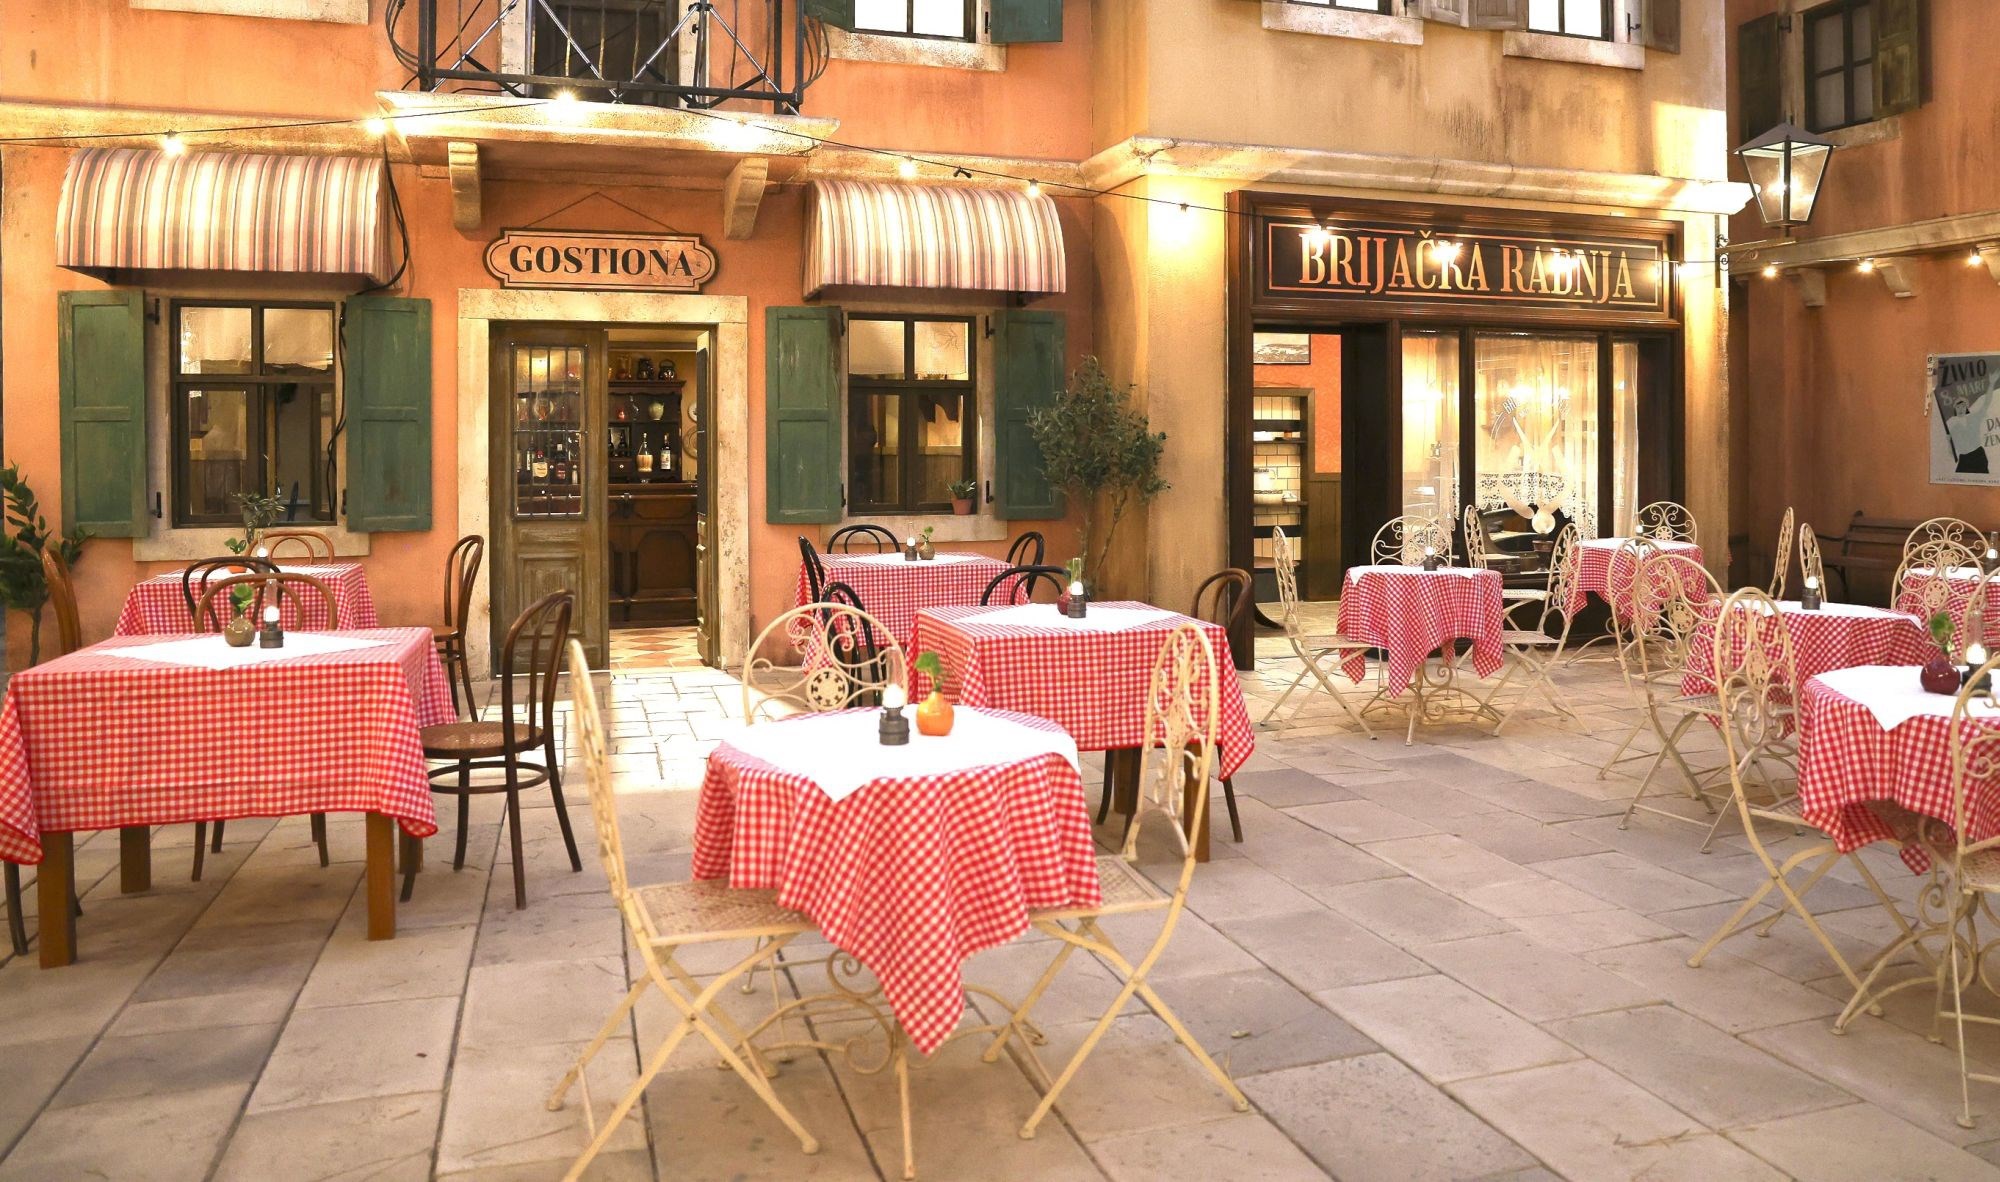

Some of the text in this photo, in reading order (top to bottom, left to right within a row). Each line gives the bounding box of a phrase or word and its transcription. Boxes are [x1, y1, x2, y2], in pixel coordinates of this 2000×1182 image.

[509, 245, 695, 276] GOSTIONA
[1299, 229, 1635, 304] BRIJAČKA RADNJA
[1938, 359, 1987, 388] ŽIVIO
